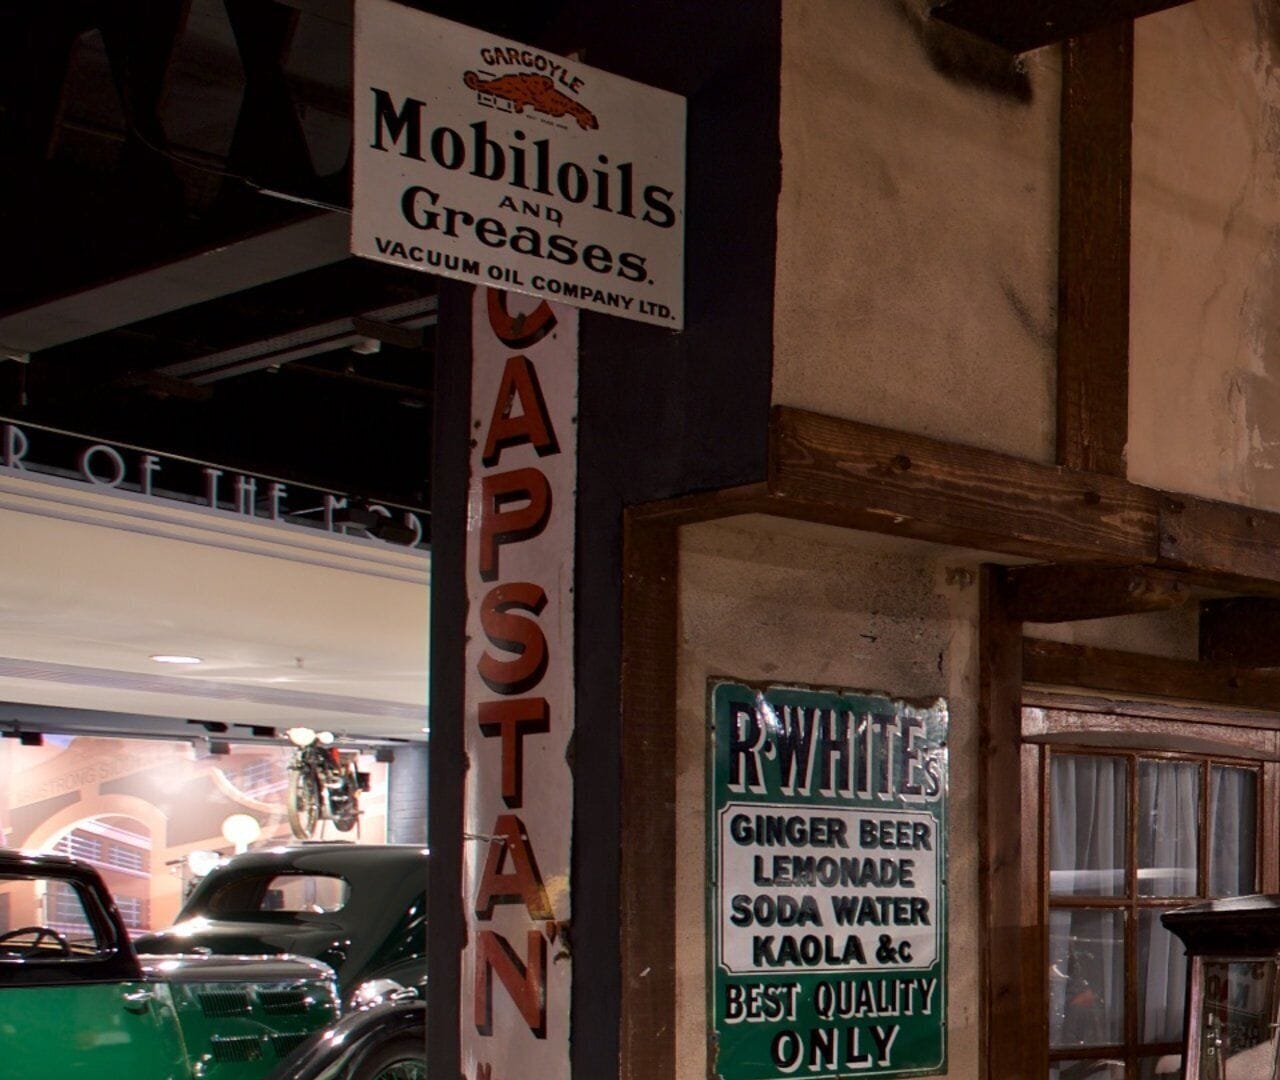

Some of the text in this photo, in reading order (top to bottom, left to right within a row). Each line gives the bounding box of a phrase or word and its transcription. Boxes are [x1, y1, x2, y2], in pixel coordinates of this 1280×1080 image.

[480, 47, 586, 95] GARGOYLE
[369, 86, 676, 229] Mobiloils
[498, 195, 564, 227] AND
[400, 185, 655, 285] Greases.
[374, 237, 677, 321] VACUUM OIL COMPANY LTD.
[82, 444, 162, 497] OF
[203, 467, 289, 522] THE
[730, 813, 932, 852] GINGER BEER
[753, 854, 916, 889] LEMONADE
[730, 894, 931, 928] SODA WATER
[753, 935, 868, 967] KAOLA
[725, 977, 938, 1023] BEST QUALITY
[771, 1024, 900, 1074] ONLY
